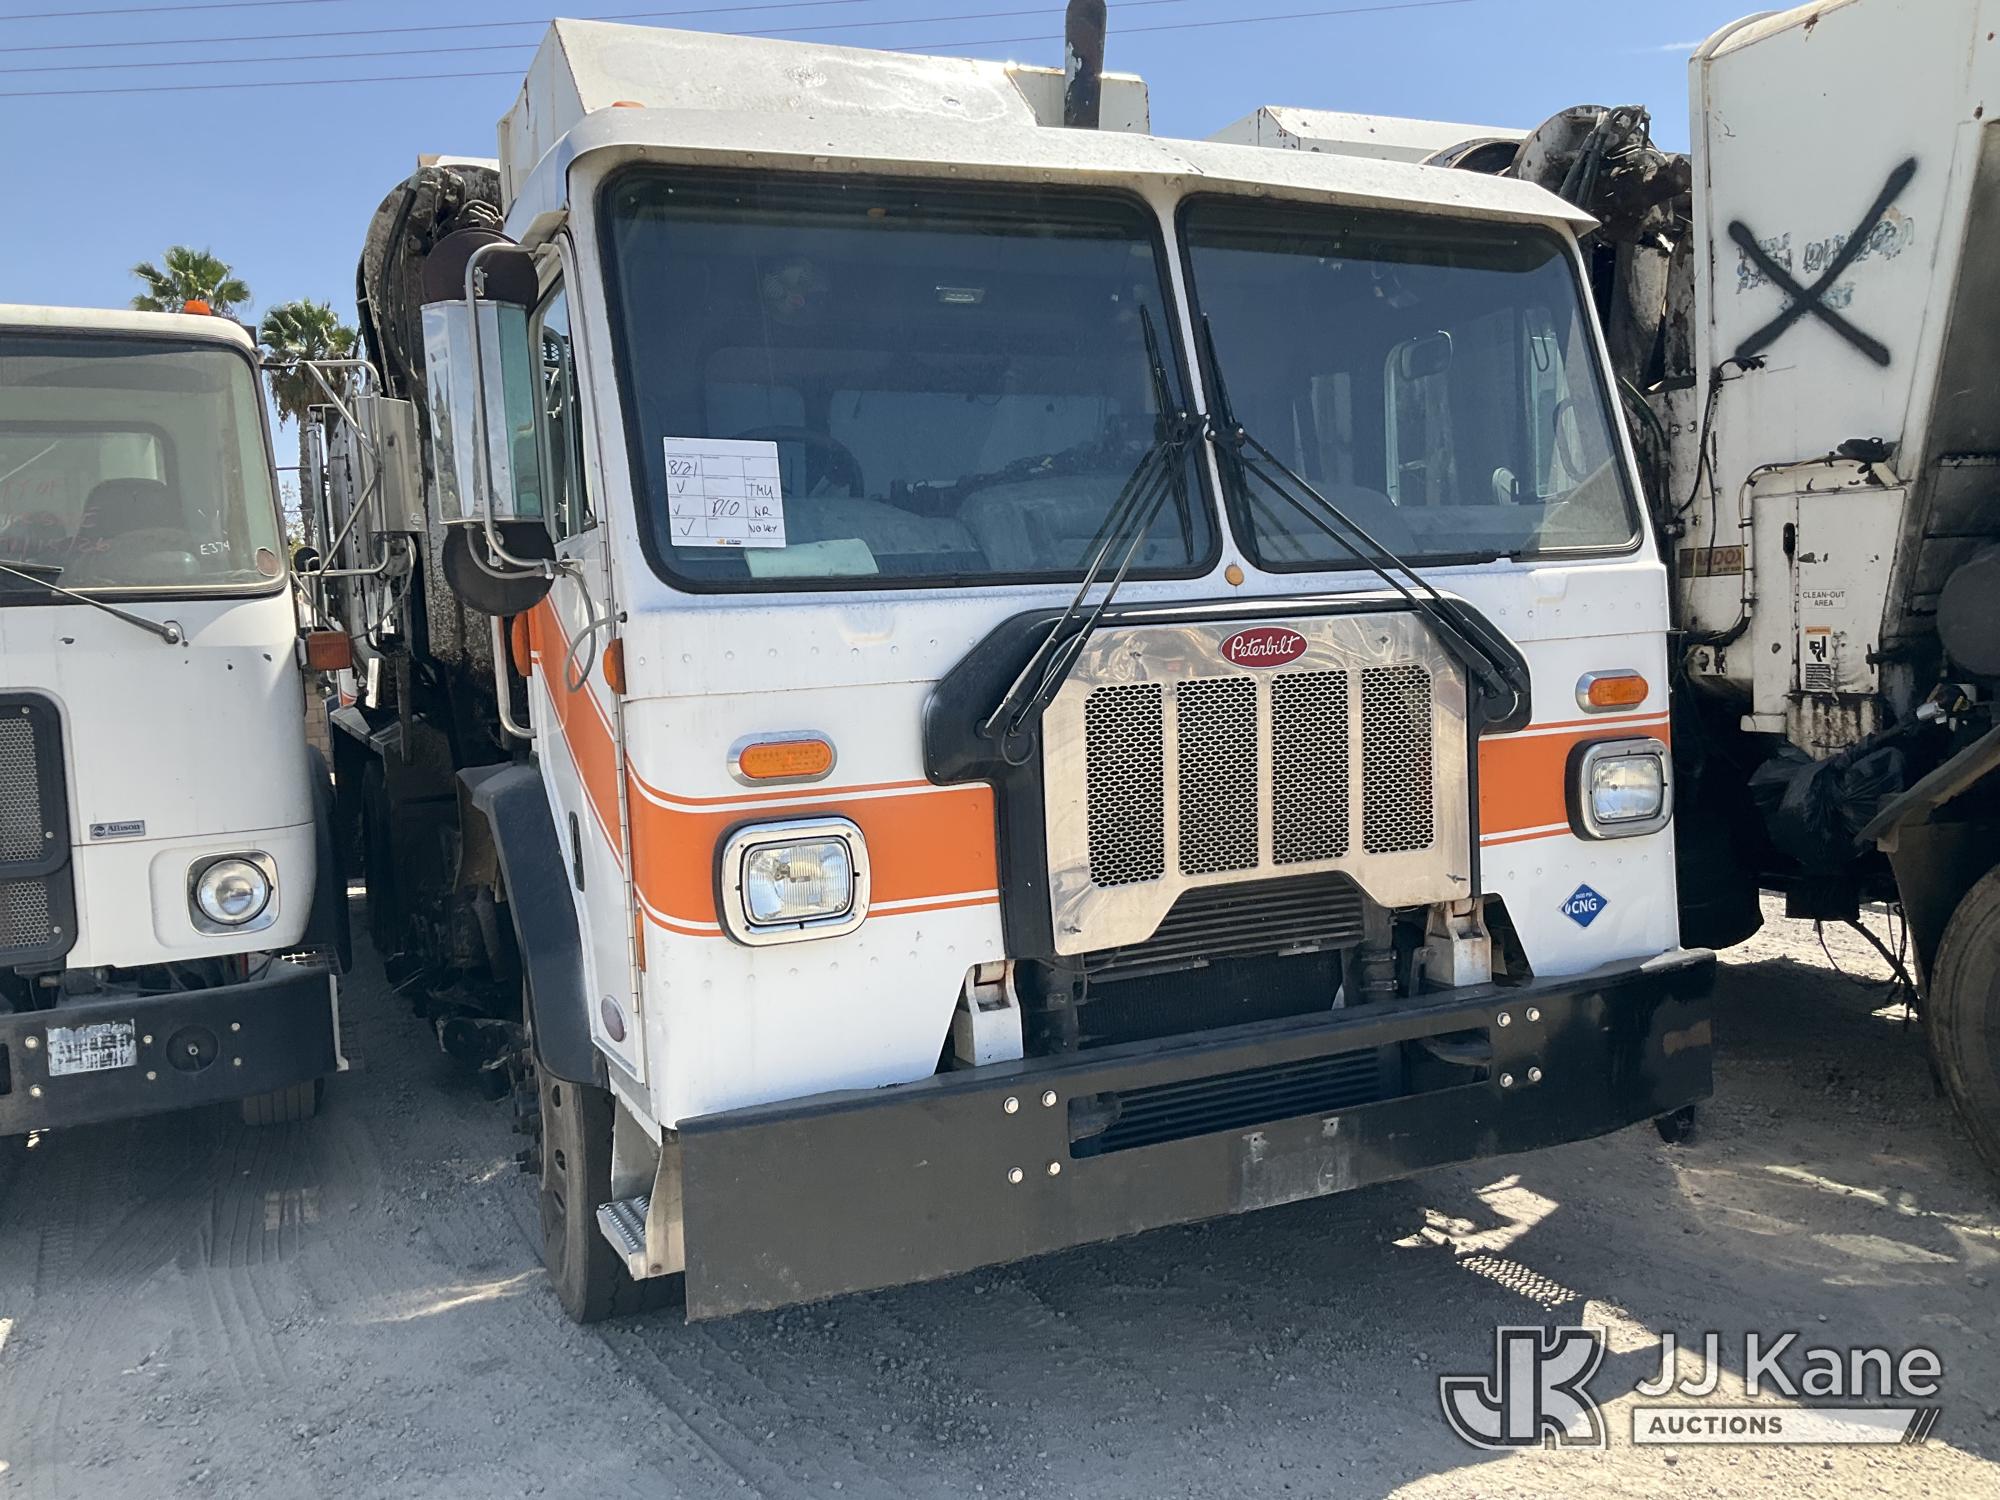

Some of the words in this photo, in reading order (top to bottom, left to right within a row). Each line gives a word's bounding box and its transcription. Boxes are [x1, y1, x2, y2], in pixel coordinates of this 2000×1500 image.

[200, 540, 231, 555] E374
[1802, 591, 1845, 599] CLEAN-OUT
[1231, 635, 1301, 660] Peterbilt
[108, 824, 141, 832] Allison
[1572, 898, 1597, 914] CNG
